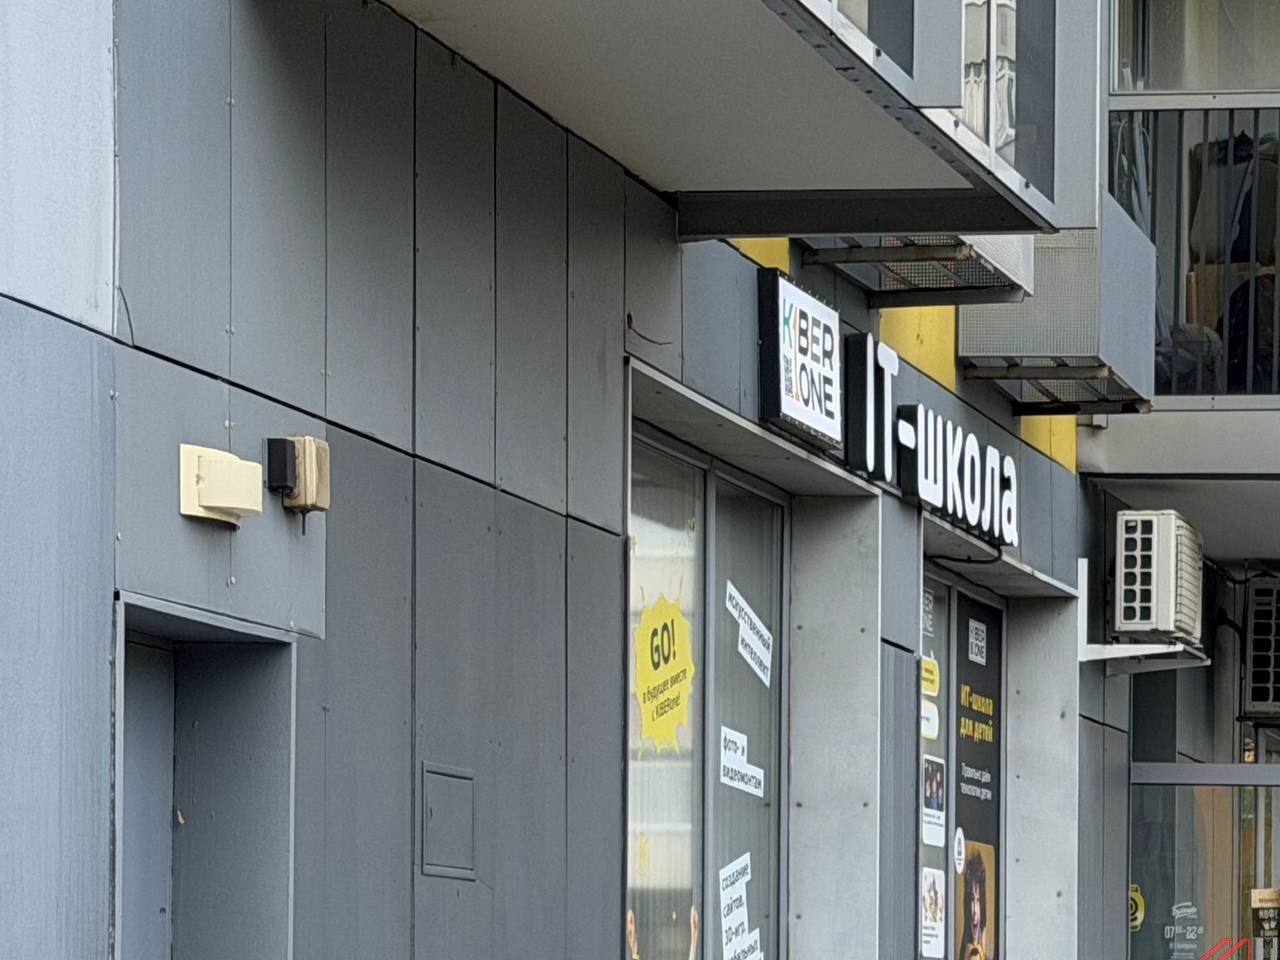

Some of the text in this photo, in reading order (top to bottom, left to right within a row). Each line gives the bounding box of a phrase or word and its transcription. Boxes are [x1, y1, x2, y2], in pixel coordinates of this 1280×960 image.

[799, 364, 835, 420] ONE
[867, 332, 1018, 547] IT-школа
[650, 619, 676, 671] GO!
[722, 863, 749, 891] создание
